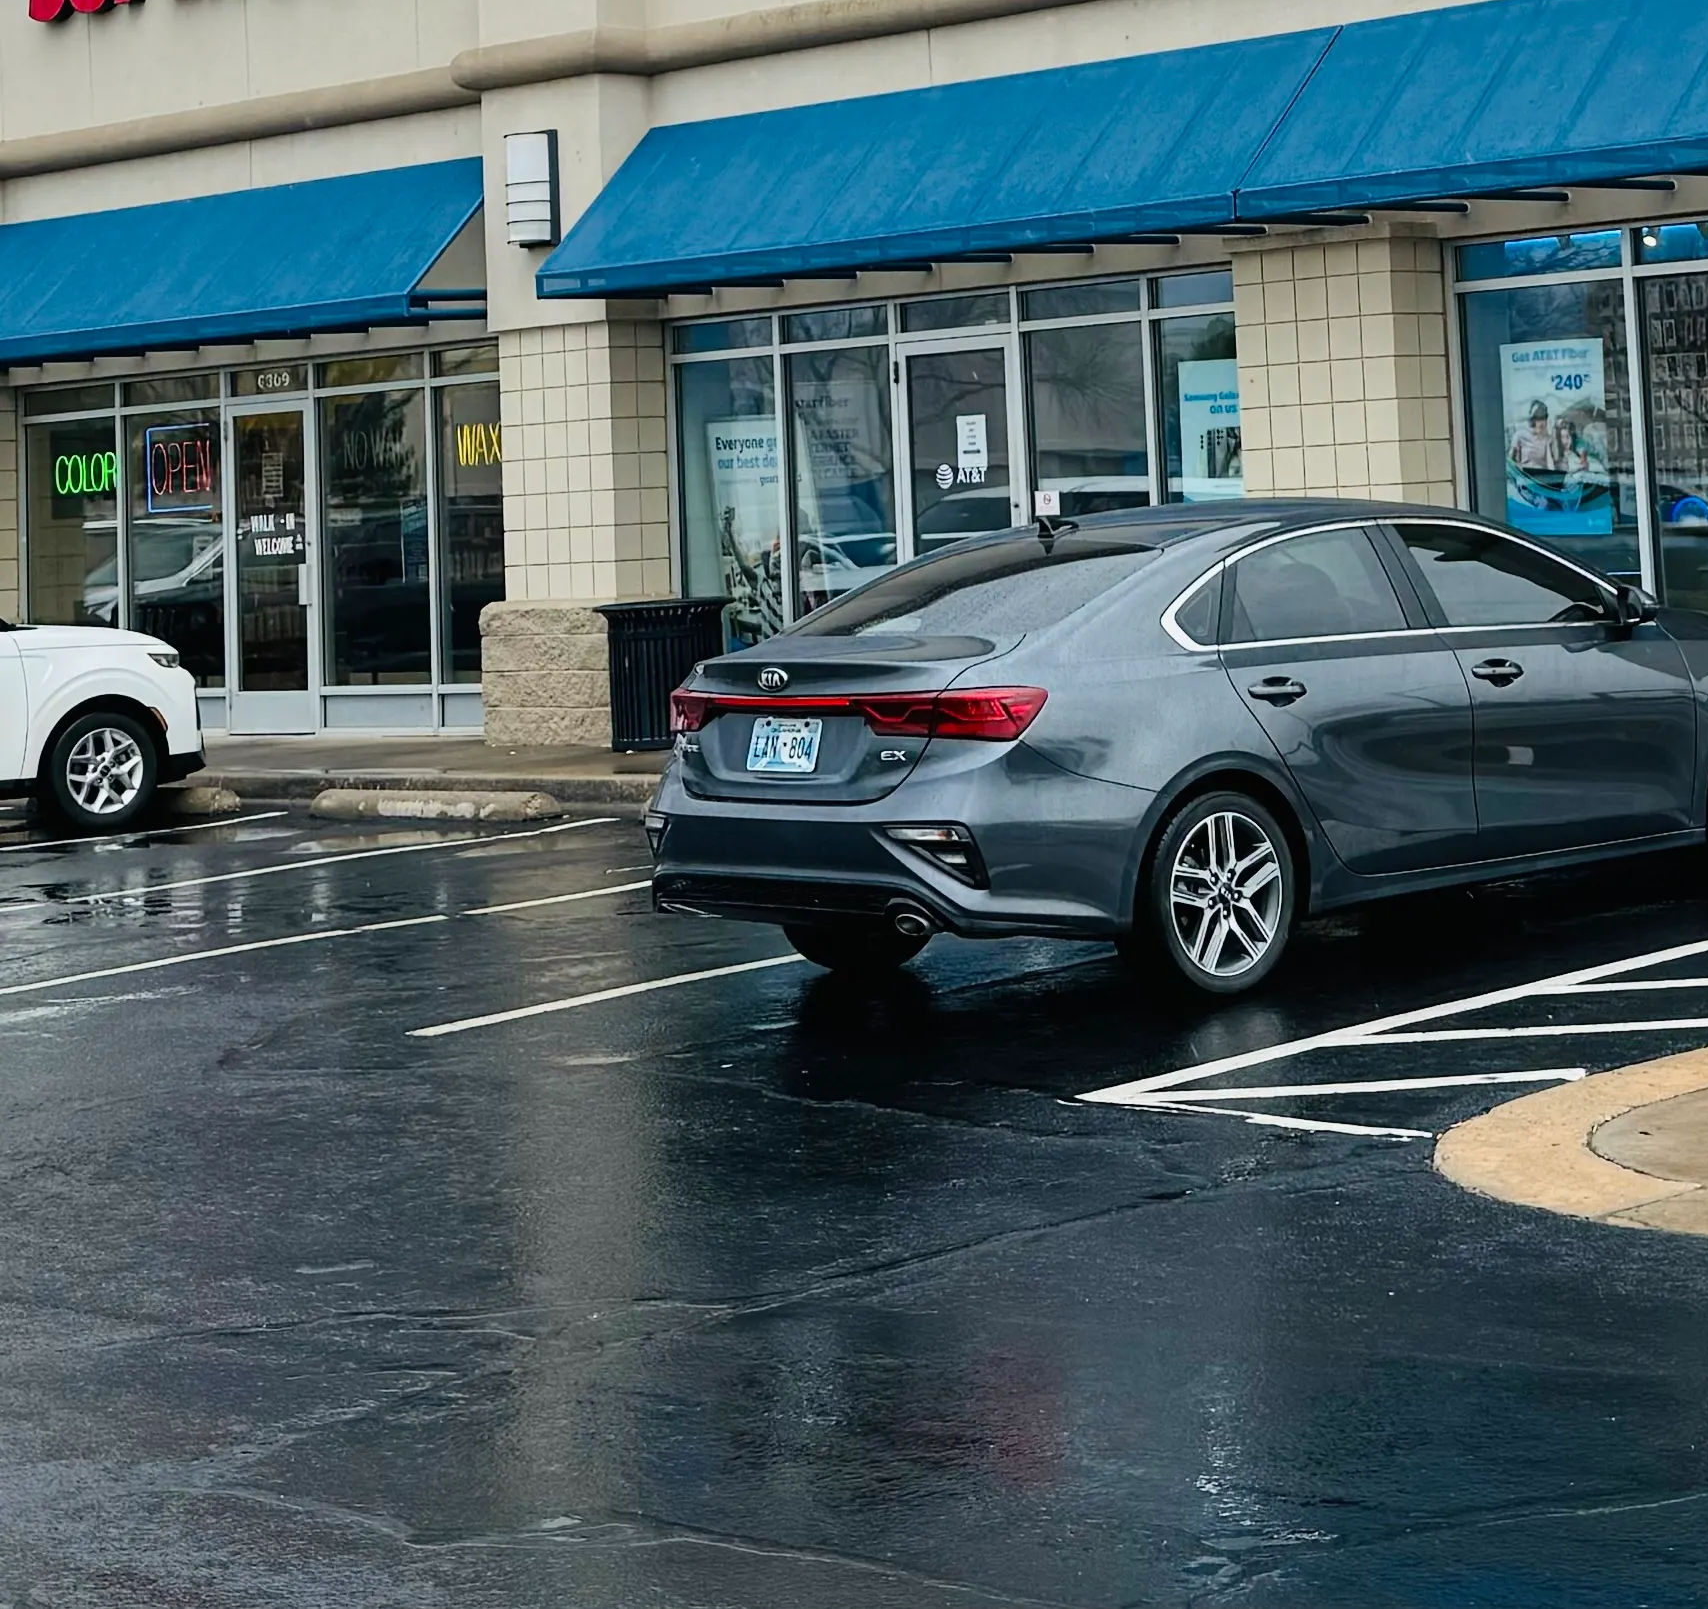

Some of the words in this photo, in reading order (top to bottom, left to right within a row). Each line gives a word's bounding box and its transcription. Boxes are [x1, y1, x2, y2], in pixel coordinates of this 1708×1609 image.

[457, 422, 500, 466] WAX
[715, 436, 764, 453] Everyone
[151, 440, 212, 495] OPEN
[737, 454, 760, 469] best
[55, 452, 117, 495] COLOR
[956, 467, 987, 484] AT&T
[760, 671, 781, 687] KIA
[880, 750, 907, 762] EX
